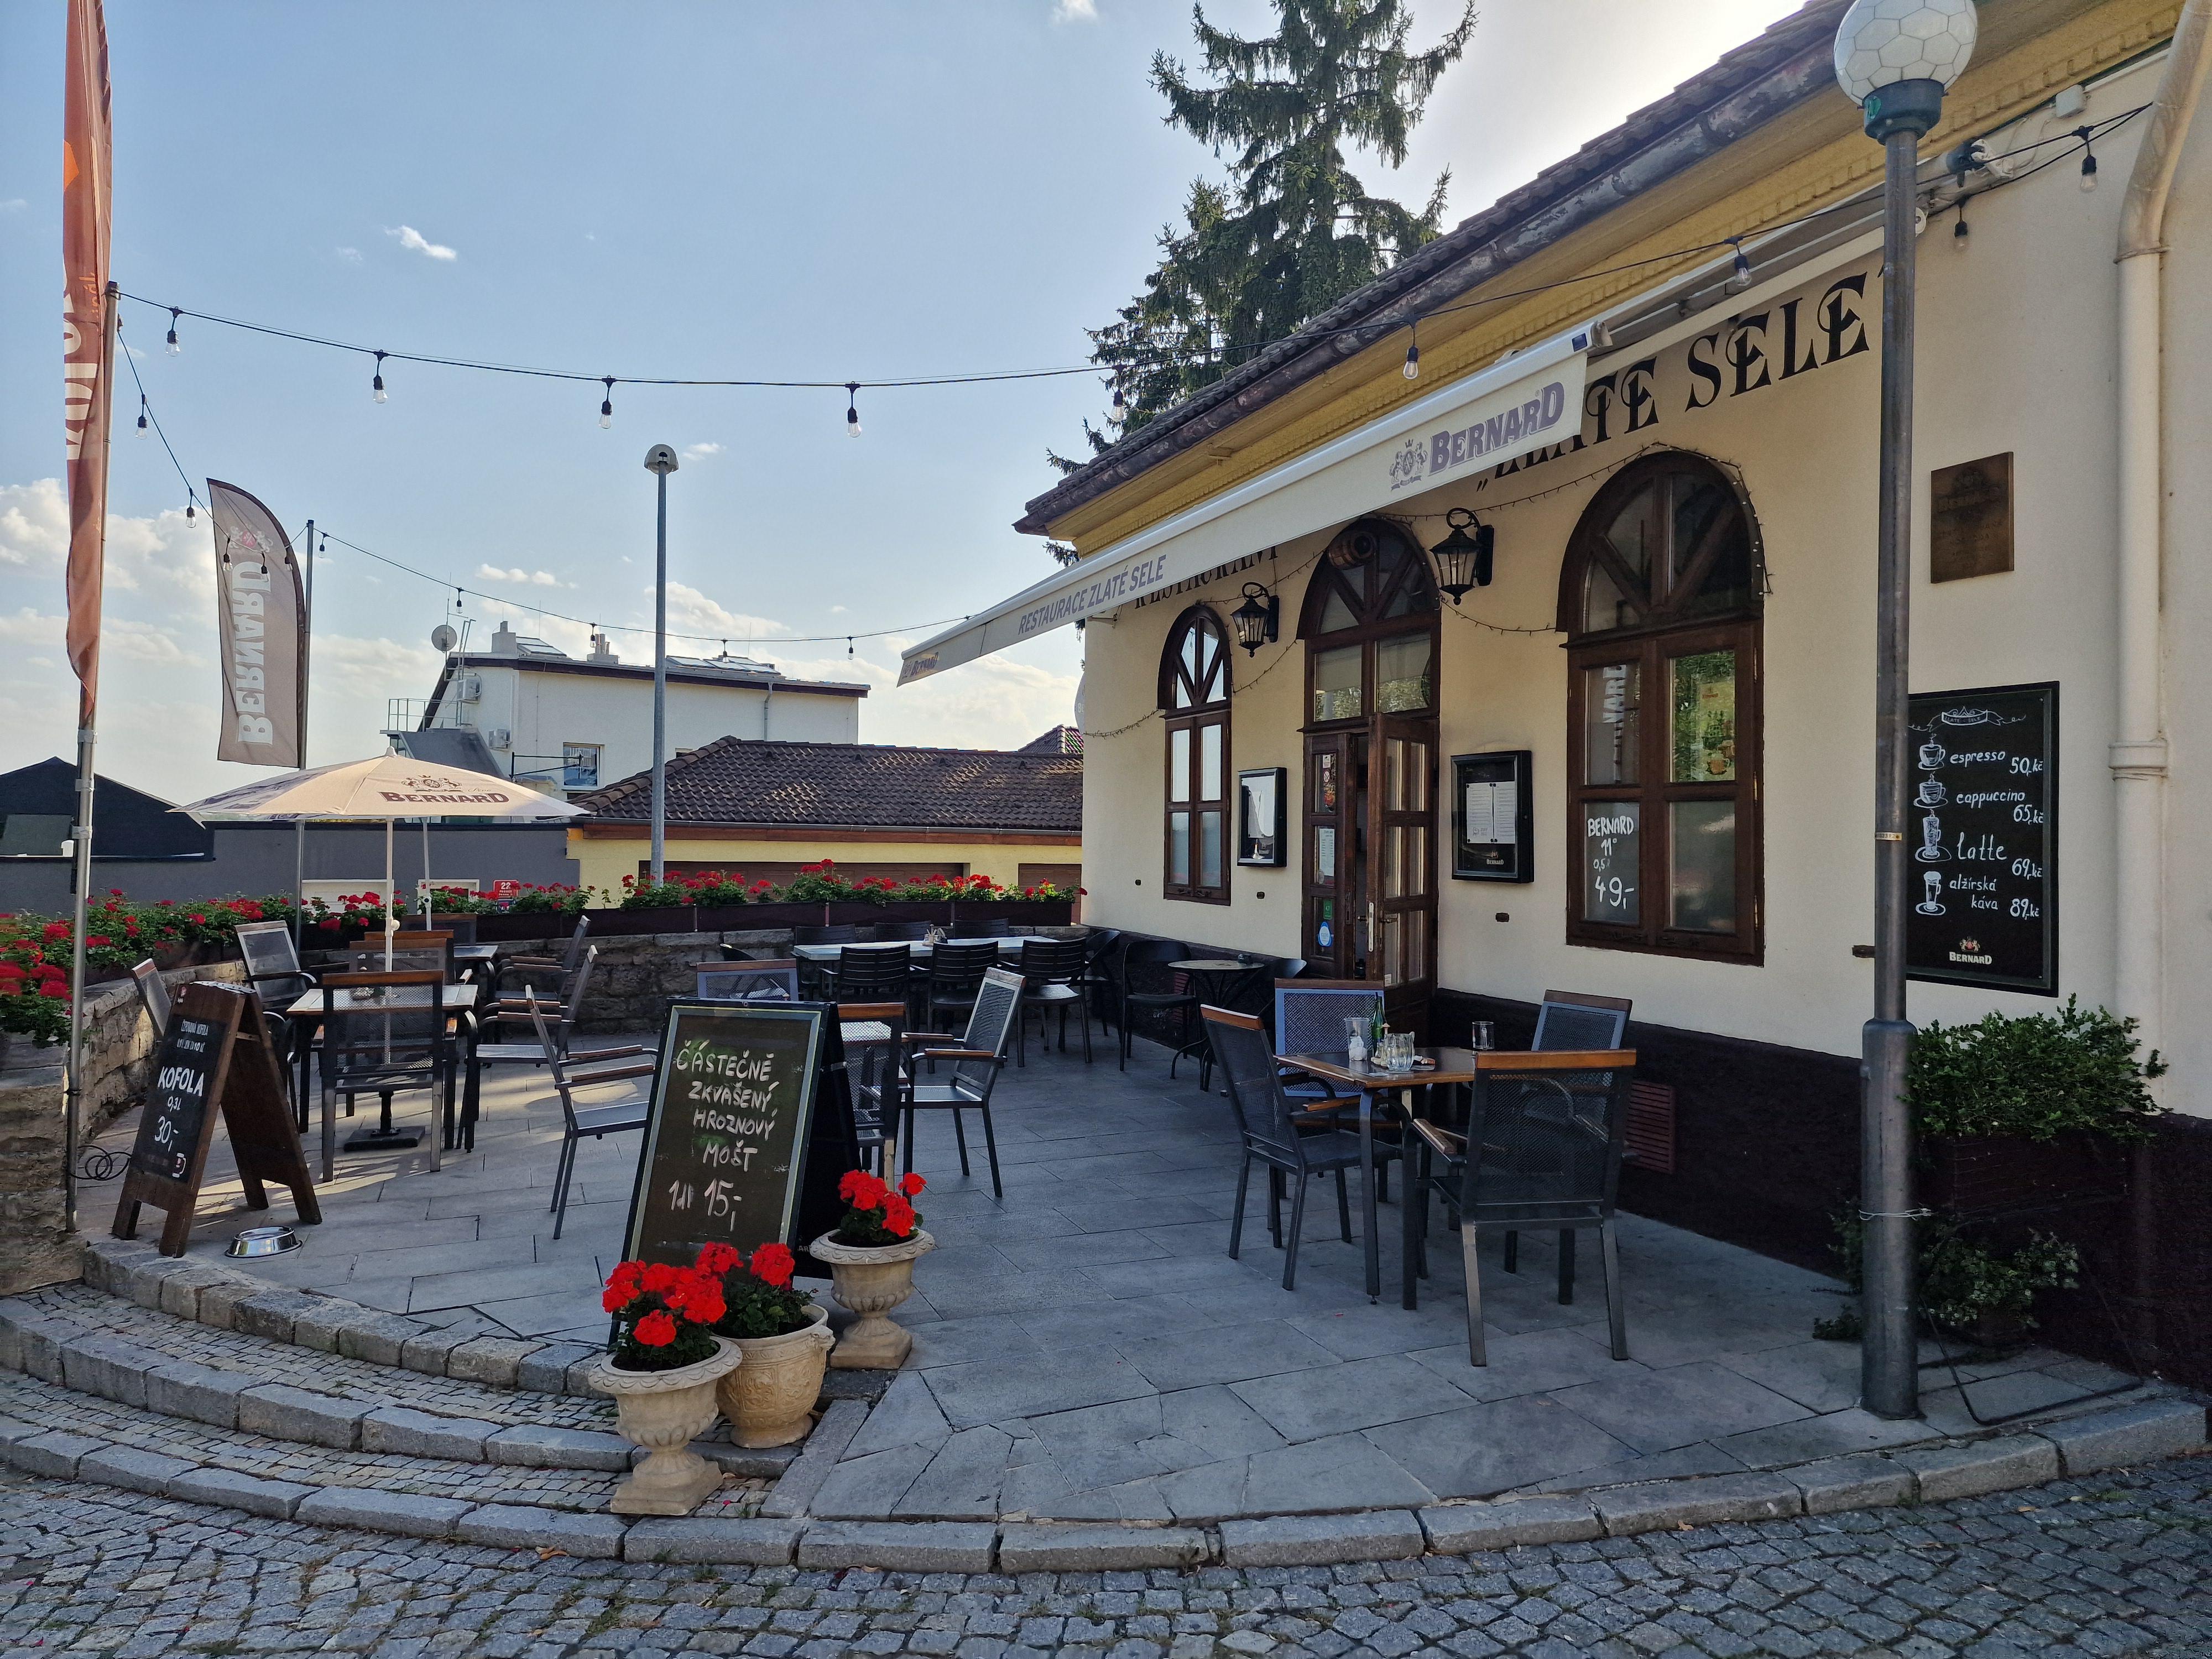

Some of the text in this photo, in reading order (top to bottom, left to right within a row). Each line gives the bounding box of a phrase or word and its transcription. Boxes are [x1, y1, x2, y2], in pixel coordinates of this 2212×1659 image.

[1429, 382, 1564, 476] BERNARD
[1019, 588, 1088, 635] RESTAURACE
[1088, 565, 1128, 608] ZLATÉ
[1129, 554, 1166, 592] SELE
[1950, 751, 2006, 768] espresso
[378, 791, 509, 803] BERNARD
[1957, 789, 2025, 808] cappuccino
[1588, 816, 1634, 837] BERNARD
[1950, 873, 1997, 891] alžírská
[1971, 894, 1999, 910] káva
[1949, 952, 1992, 965] BERNARD
[158, 1066, 204, 1097] KOFOLA
[688, 1081, 780, 1113] ZKVAŠENÝ
[693, 1108, 778, 1141] HROZNOVÝ
[703, 1139, 759, 1171] MOŠT
